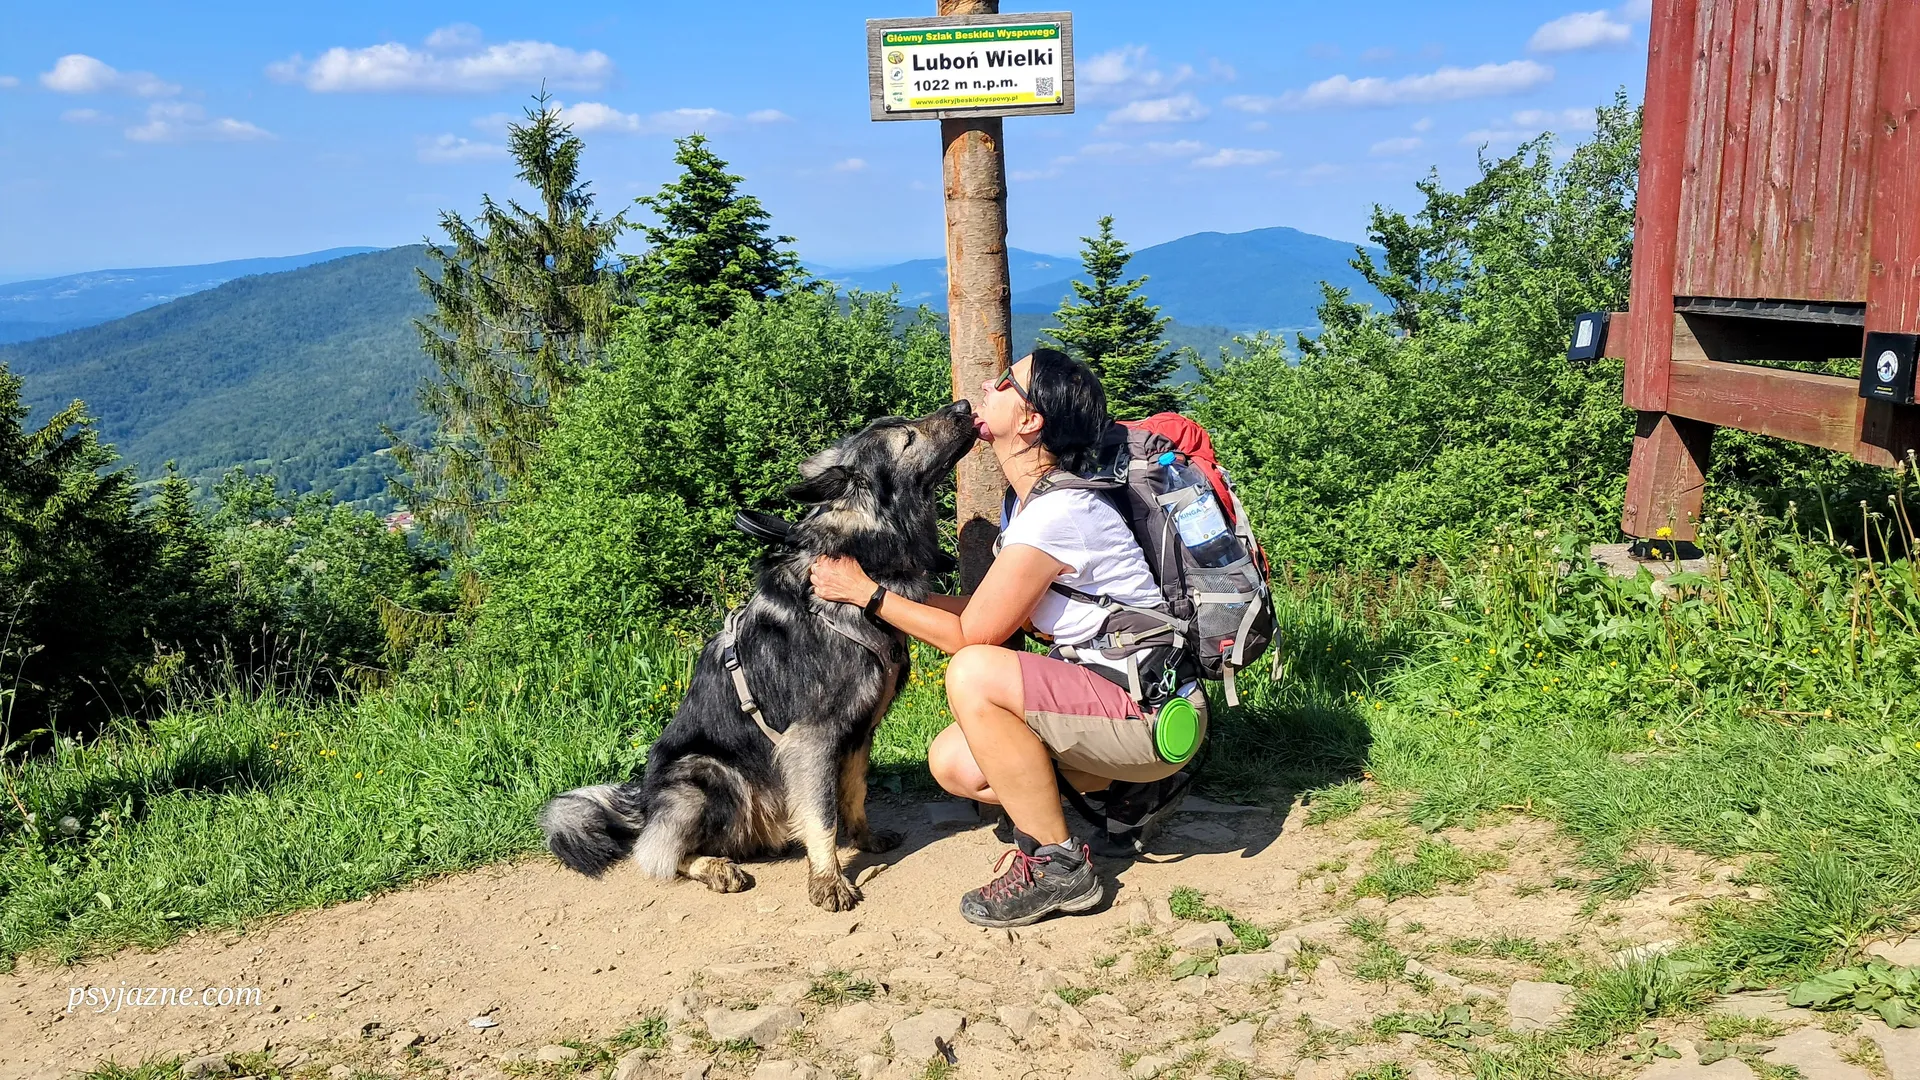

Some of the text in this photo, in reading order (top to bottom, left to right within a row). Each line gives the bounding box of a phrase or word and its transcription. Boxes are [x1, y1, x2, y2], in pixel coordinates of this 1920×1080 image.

[886, 28, 1055, 44] Główny Szlak Beskidu Wyspowego
[912, 48, 1053, 72] Luboń Wielki
[914, 79, 950, 92] 1022
[955, 80, 968, 90] m
[973, 77, 1018, 91] n.p.m.
[915, 95, 1019, 106] www.odkryjbeskidwyspowy.pl
